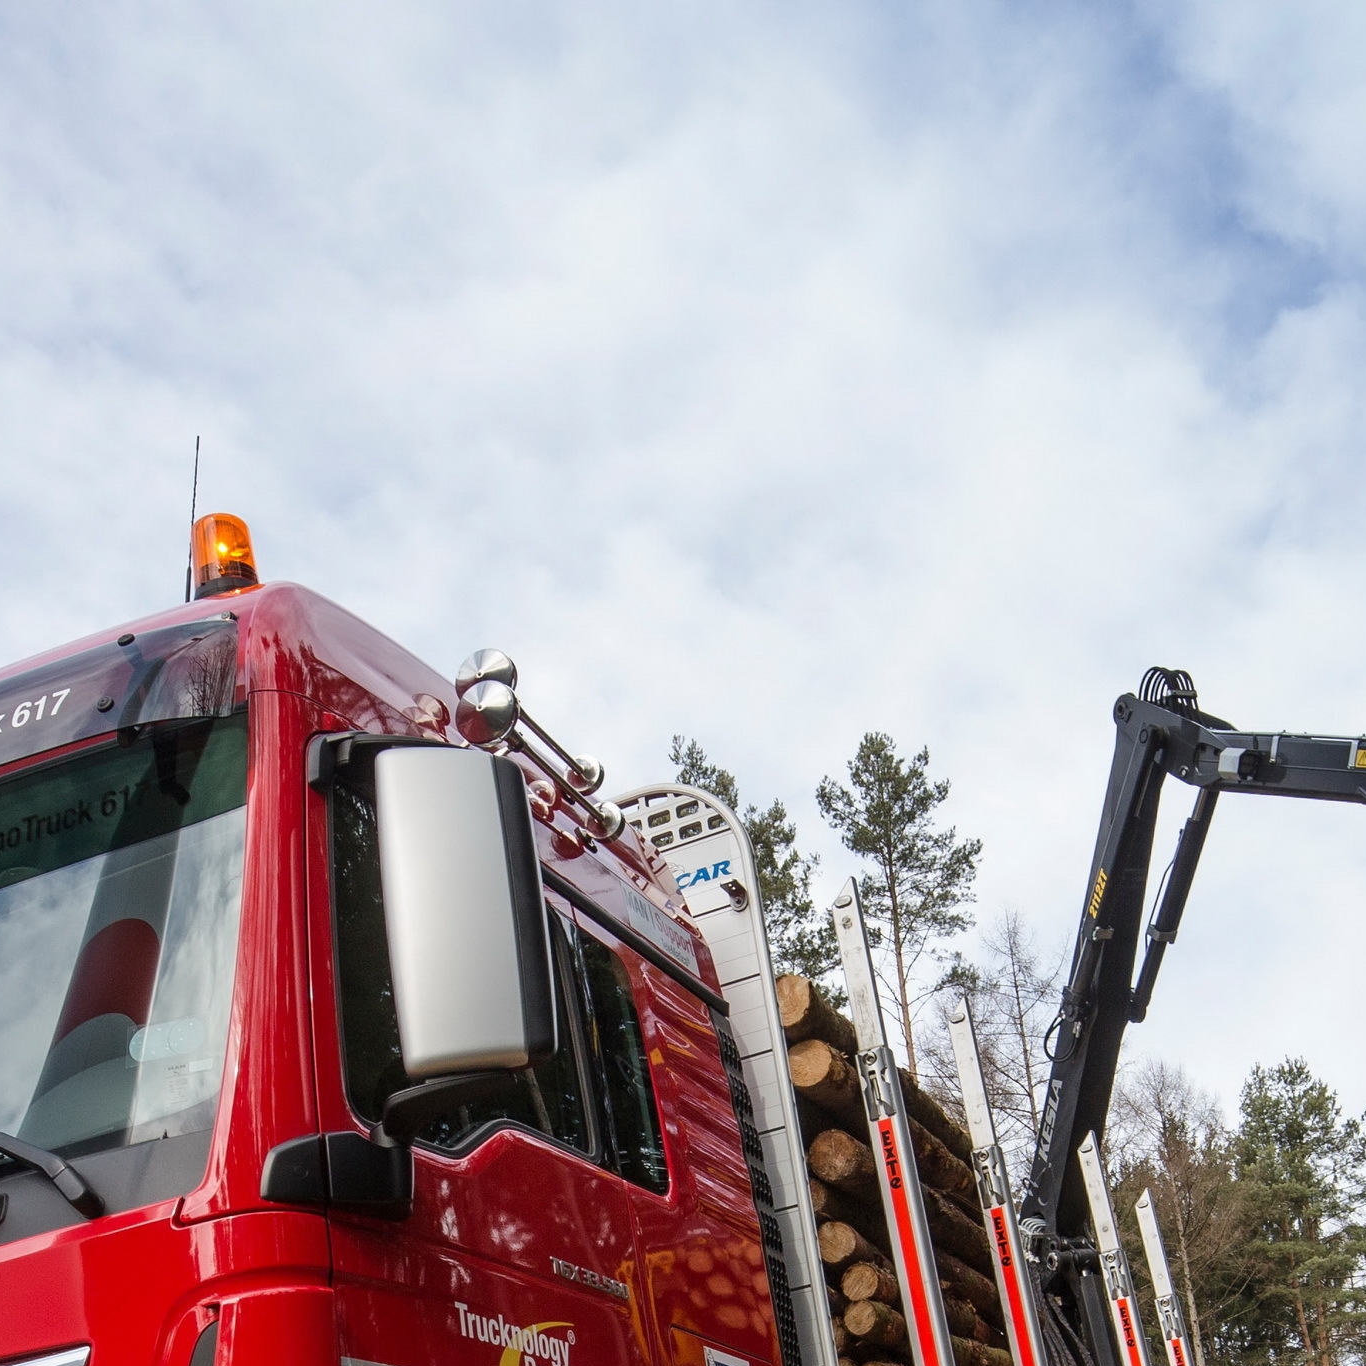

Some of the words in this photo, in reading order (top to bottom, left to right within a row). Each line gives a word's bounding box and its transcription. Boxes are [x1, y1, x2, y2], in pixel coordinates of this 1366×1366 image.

[11, 688, 71, 729] 617
[1089, 867, 1108, 919] 2112ZT
[655, 914, 696, 957] Support
[1038, 1079, 1063, 1163] KESLA
[549, 1256, 582, 1283] TGX
